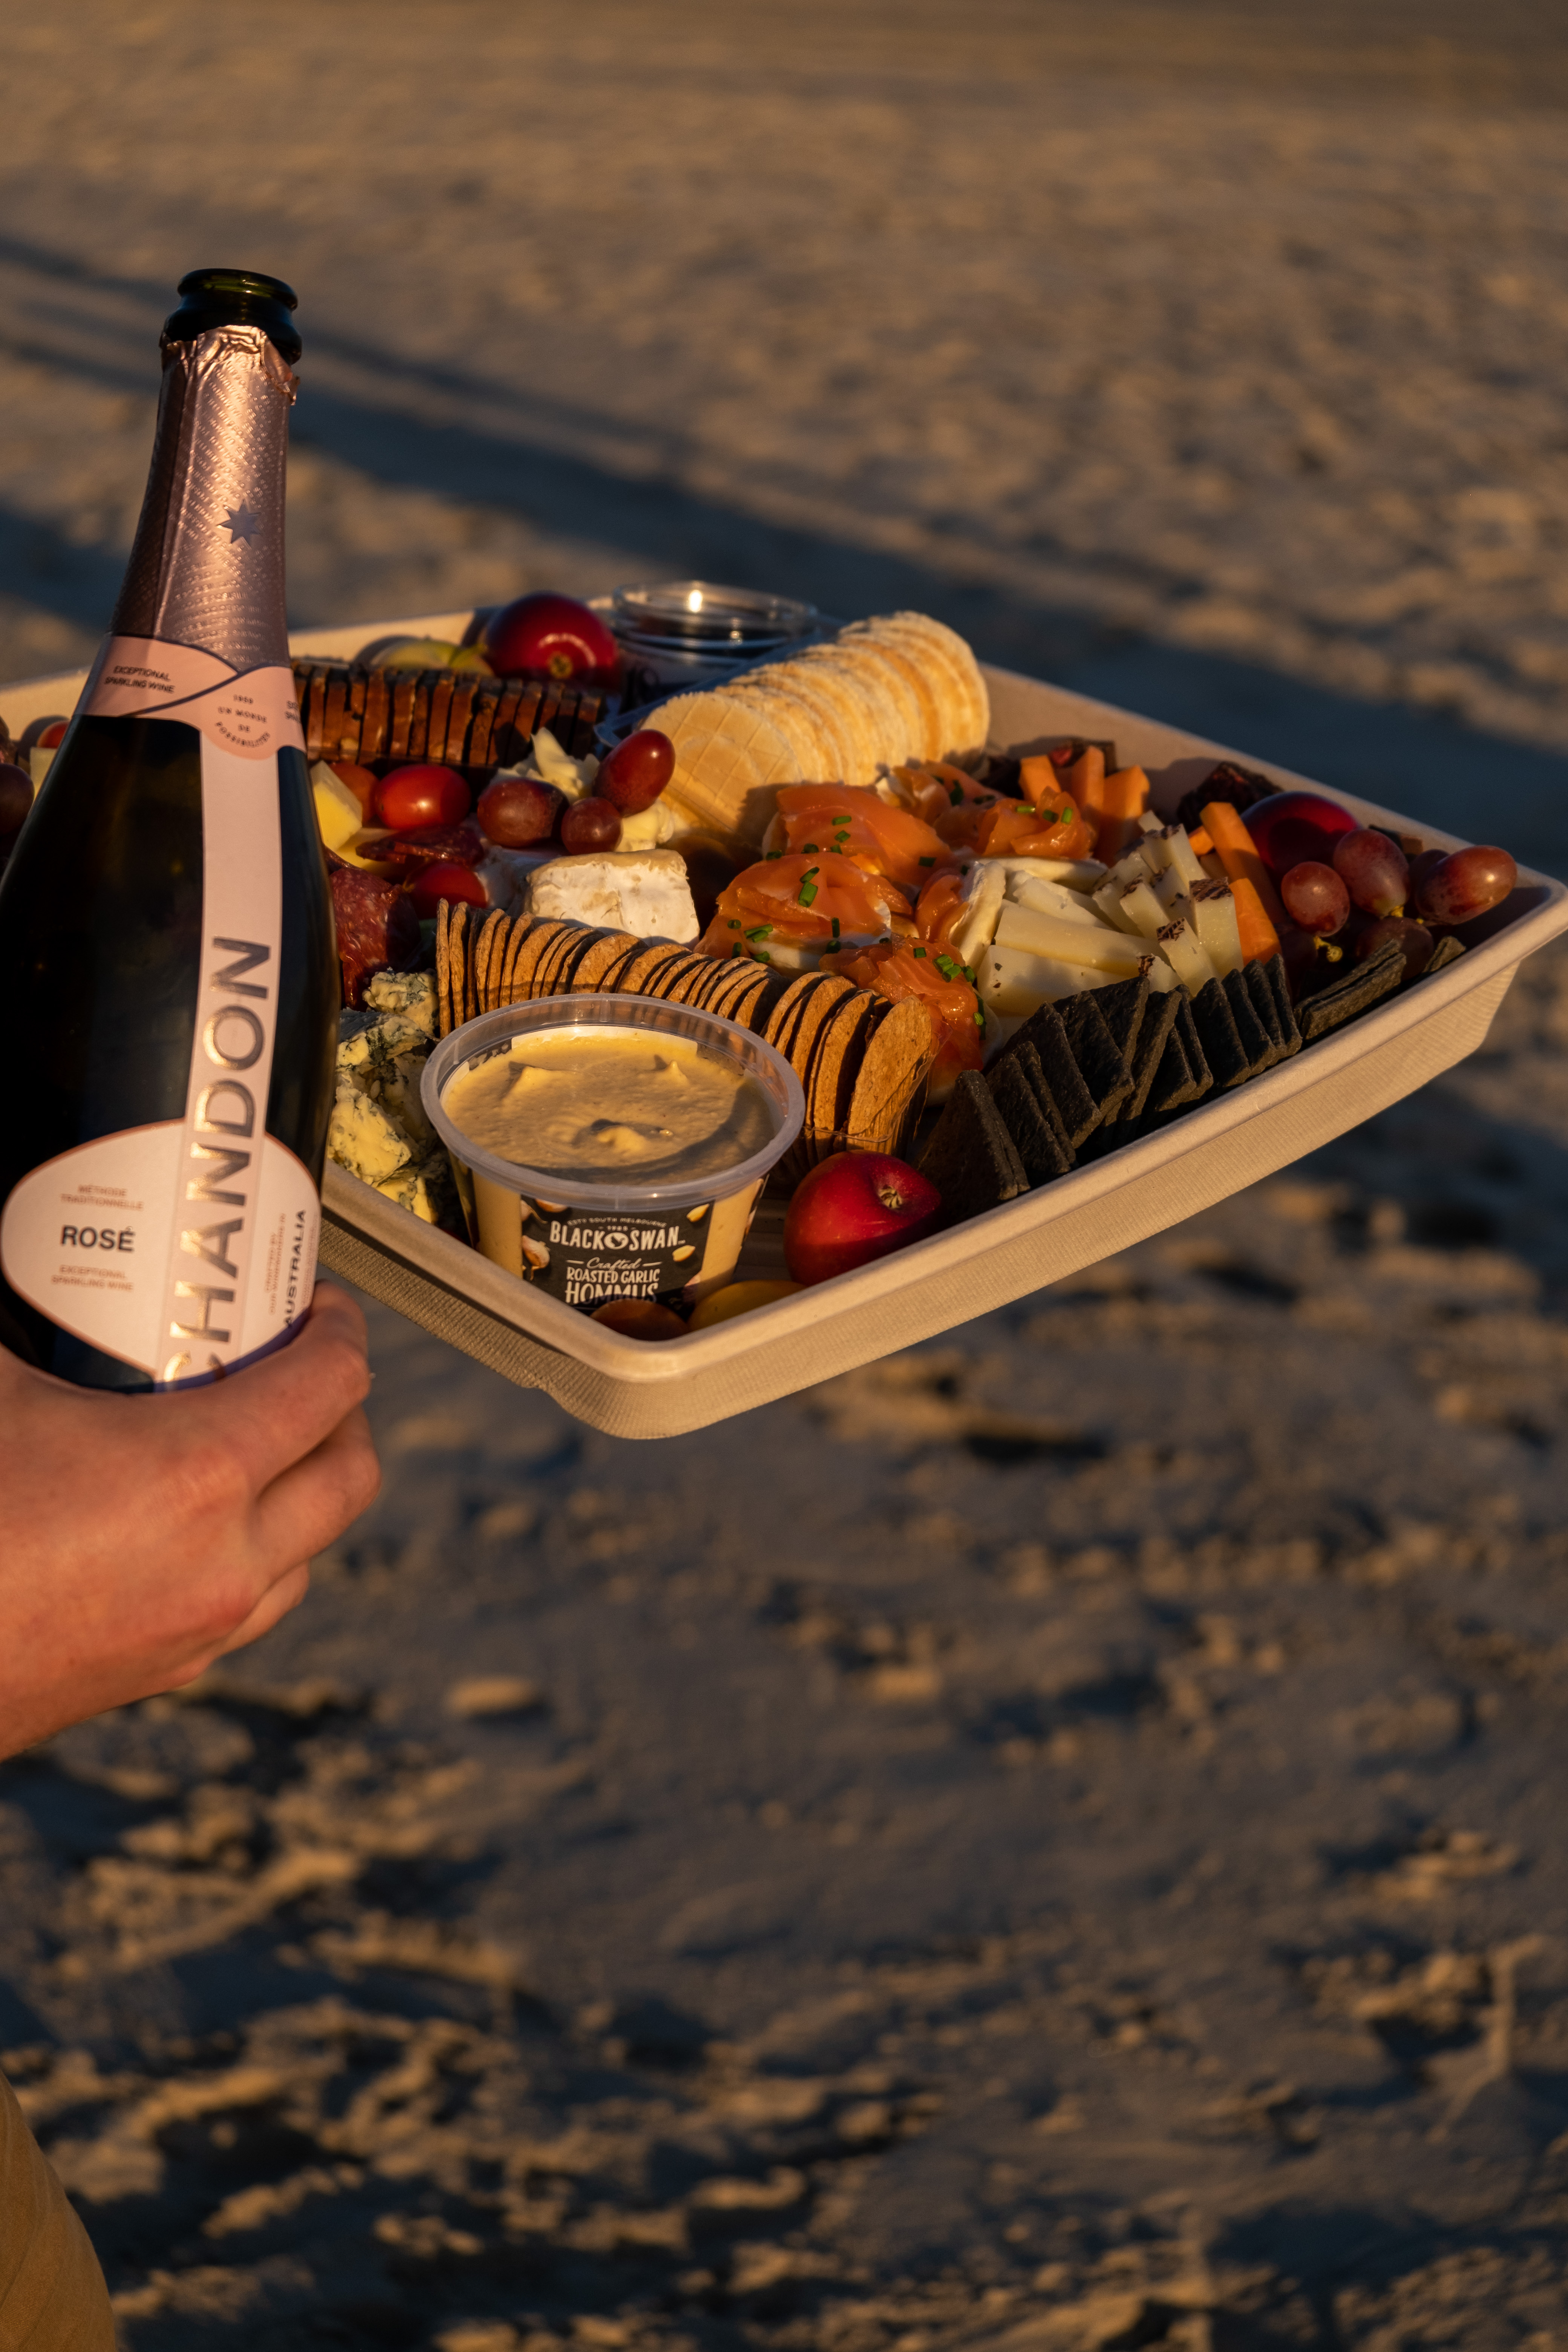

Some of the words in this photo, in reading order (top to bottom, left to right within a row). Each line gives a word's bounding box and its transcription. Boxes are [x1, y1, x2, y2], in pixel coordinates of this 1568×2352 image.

[114, 665, 170, 681] EXCEPTIONAL
[104, 676, 147, 689] SPARKLING
[148, 681, 175, 694] WINE
[620, 1217, 667, 1228] MELBOURNE
[60, 1225, 135, 1254] ROSÉ
[549, 1220, 605, 1251] BLACK
[628, 1225, 680, 1251] SWAN
[59, 1265, 126, 1279] EXCEPTIONAL
[283, 1209, 306, 1328] AUSTRALIA
[586, 1257, 642, 1272] Crafted
[51, 1275, 105, 1289] SPARKLING
[106, 1282, 133, 1292] WINE
[566, 1266, 619, 1283] ROASTED
[620, 1268, 660, 1284] GARLIC
[565, 1281, 659, 1304] HOMMUS
